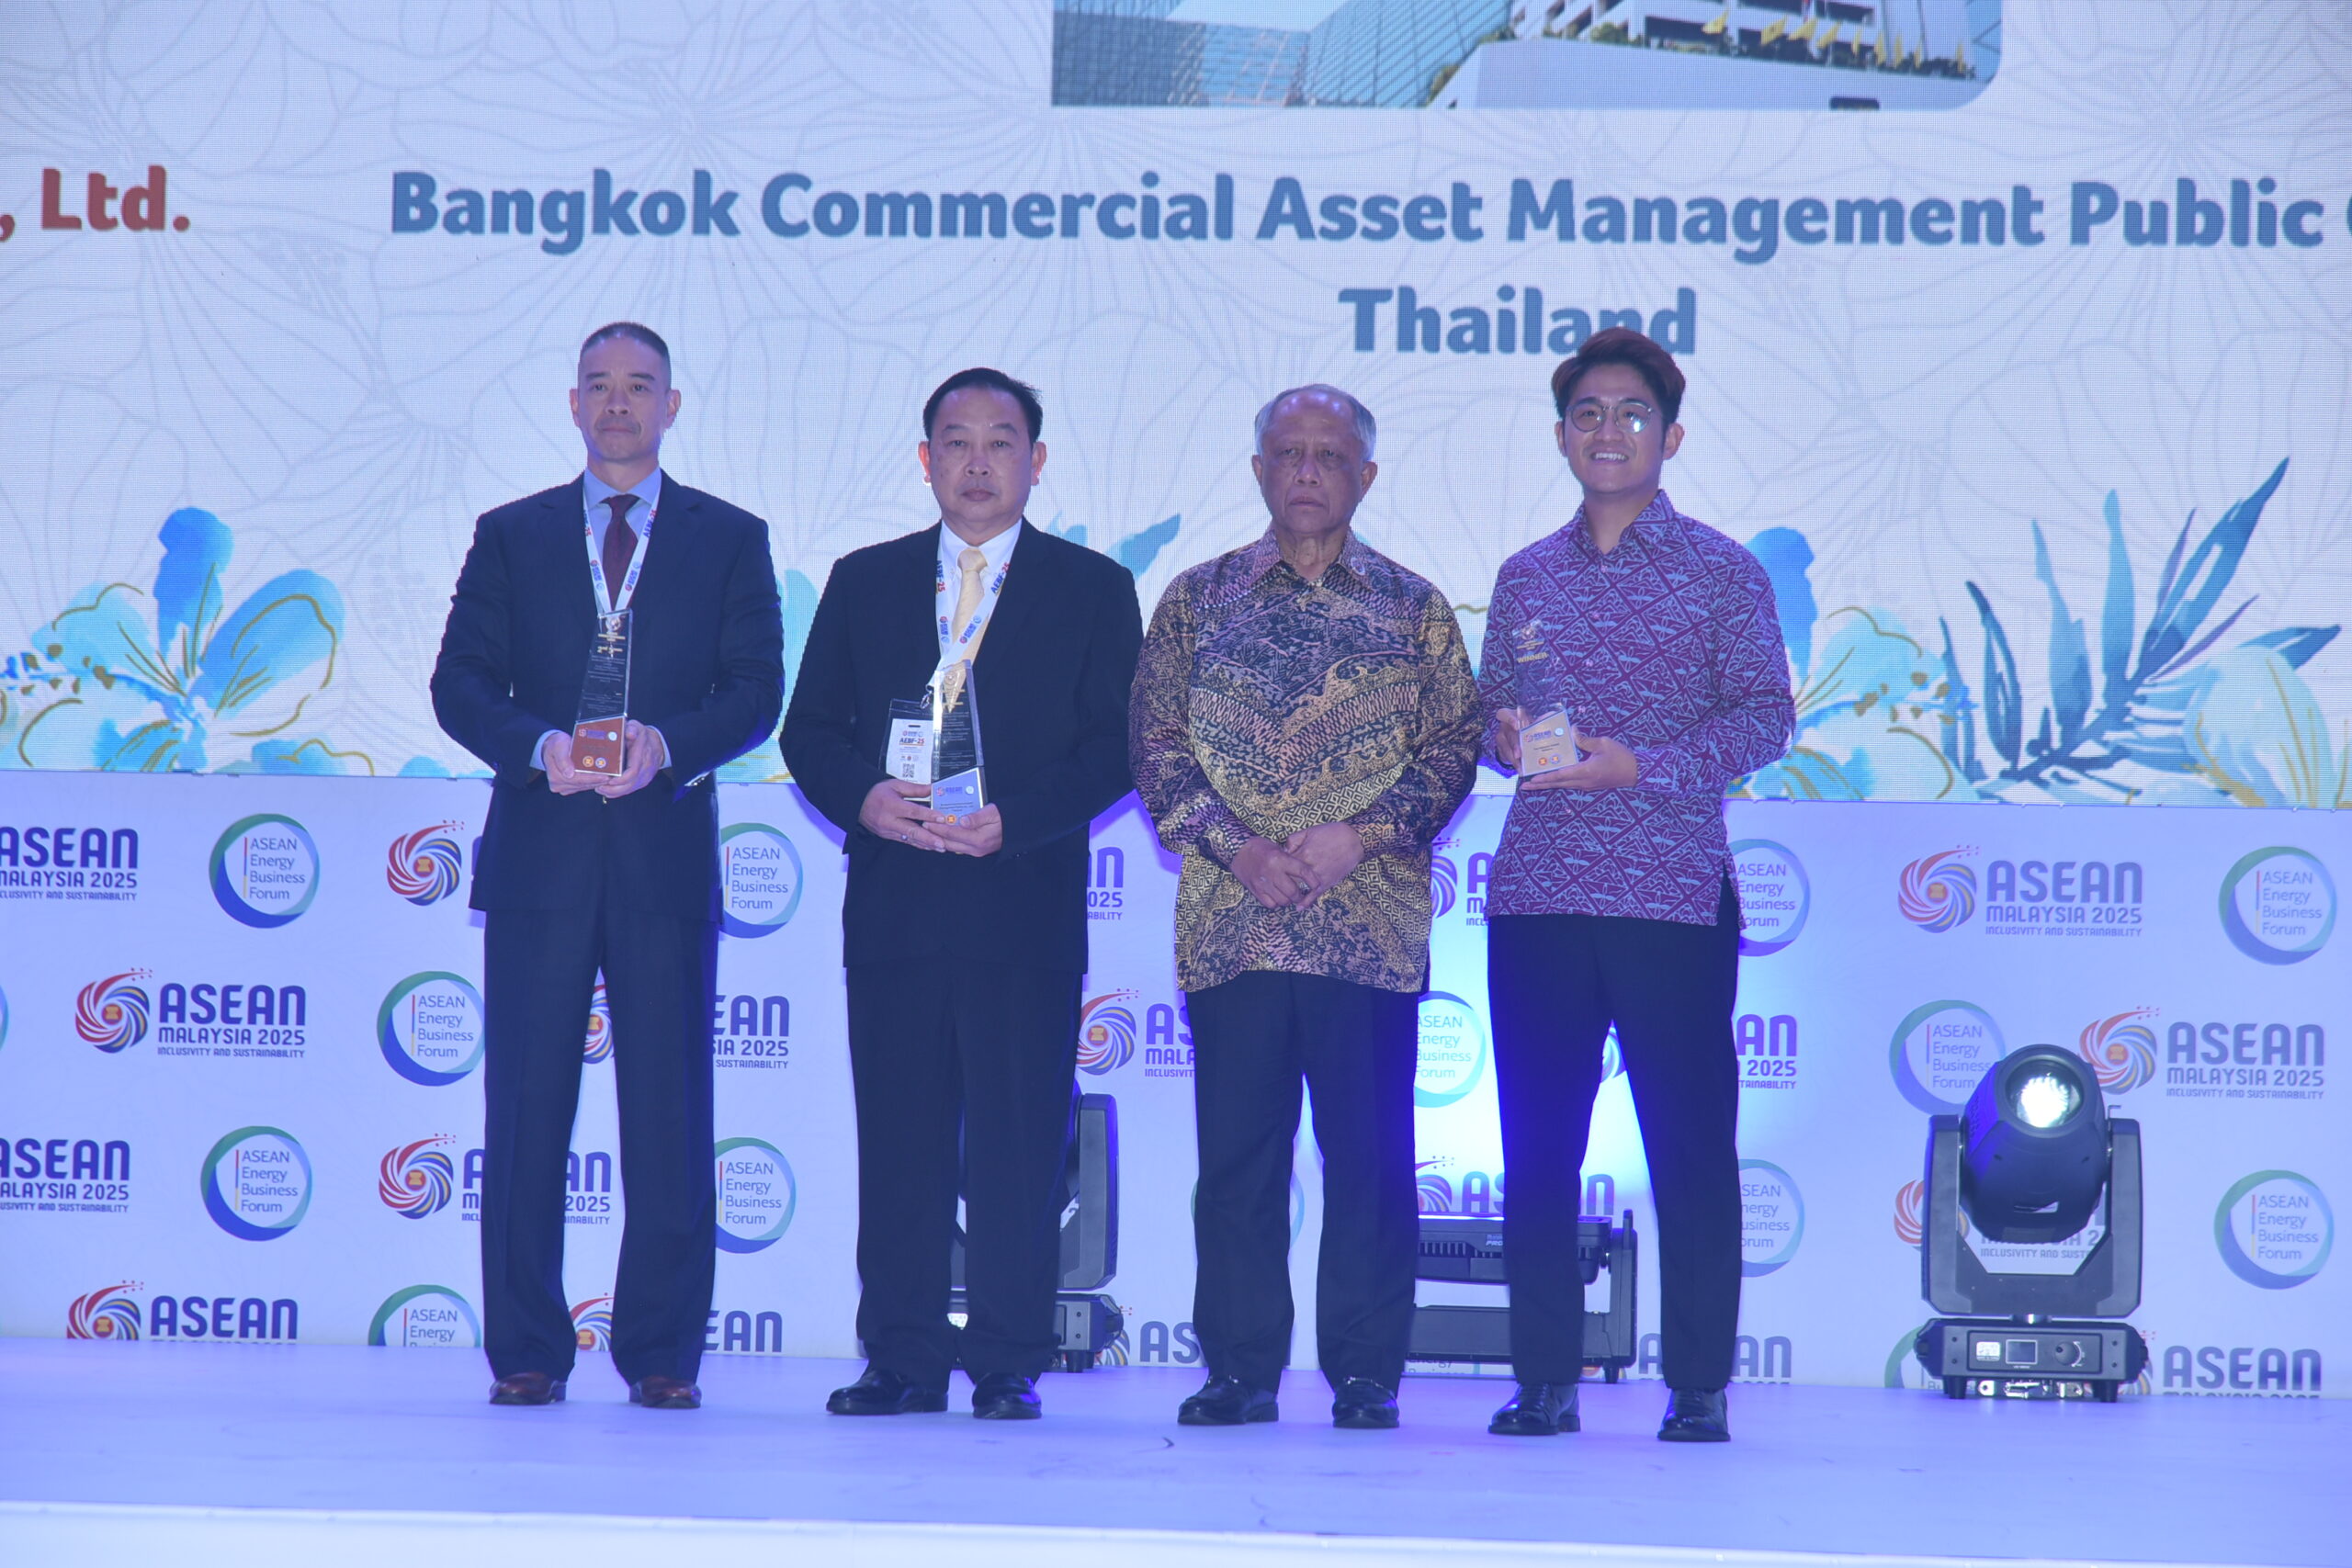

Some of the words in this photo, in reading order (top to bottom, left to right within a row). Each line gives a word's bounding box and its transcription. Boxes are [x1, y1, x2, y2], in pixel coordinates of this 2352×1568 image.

[42, 165, 190, 231] Ltd.
[392, 168, 740, 255] Bangkok
[761, 171, 1233, 240] Commercial
[1257, 176, 1485, 242] Asset
[1507, 178, 2045, 265] Management
[2070, 178, 2325, 248] Public
[0, 827, 138, 869] ASEAN
[250, 838, 297, 851] ASEAN
[732, 847, 781, 861] ASEAN
[251, 854, 295, 870] Energy
[732, 863, 778, 880] Energy
[1737, 863, 1786, 876] ASEAN
[90, 872, 138, 888] 2025
[249, 871, 306, 884] Business
[1986, 860, 2143, 904] ASEAN
[2262, 872, 2312, 886] ASEAN
[249, 887, 290, 900] Forum
[731, 880, 788, 894] Business
[0, 890, 43, 899] CLUSIVITY
[46, 891, 63, 900] AND
[65, 891, 137, 901] SUSTAINABILITY
[1088, 891, 1123, 908] 025
[2263, 888, 2311, 905] Energy
[731, 897, 773, 909] Forum
[1986, 906, 2086, 923] MALAYSIA
[2091, 908, 2143, 924] 2025
[2263, 905, 2322, 919] Business
[1745, 917, 1780, 927] orum
[2262, 922, 2306, 936] Forum
[1985, 926, 2041, 935] INCLUSIVITY
[2044, 926, 2063, 936] AND
[2065, 927, 2142, 937] SUSTAINABILITY
[159, 983, 306, 1026] ASEAN
[418, 995, 466, 1009] ASEAN
[418, 1011, 463, 1028] Energy
[713, 995, 789, 1037] EAN
[158, 1027, 251, 1045] MALAYSIA
[257, 1028, 305, 1046] 2025
[417, 1028, 474, 1042] Business
[1933, 1024, 1983, 1038] ASEAN
[741, 1039, 789, 1056] 2025
[1933, 1042, 1980, 1058] Energy
[2166, 1021, 2324, 1066] ASEAN
[157, 1046, 211, 1056] INCLUSIVITY
[213, 1047, 231, 1057] AND
[233, 1048, 305, 1058] SUSTAINABILITY
[417, 1045, 458, 1058] Forum
[1146, 1048, 1195, 1066] MALA
[716, 1059, 788, 1069] SUSTAINABILITY
[1747, 1059, 1797, 1077] 2025
[1145, 1068, 1195, 1077] INCLUSIVIT
[2166, 1066, 2267, 1085] MALAYSIA
[2273, 1069, 2324, 1087] 2025
[1738, 1080, 1796, 1089] TAINABILITY
[1933, 1076, 1975, 1089] Forum
[2166, 1088, 2222, 1098] INCLUSIVITY
[2226, 1089, 2245, 1099] AND
[2247, 1089, 2324, 1100] SUSTAINABILITY
[242, 1151, 290, 1163] ASEAN
[242, 1168, 288, 1183] Energy
[725, 1162, 774, 1176] ASEAN
[0, 1181, 76, 1199] ALAYSIA
[83, 1183, 130, 1201] 2025
[242, 1184, 299, 1197] Business
[726, 1179, 772, 1195] Energy
[1742, 1184, 1781, 1197] SEAN
[0, 1201, 36, 1211] USIVITY
[38, 1202, 56, 1212] AND
[58, 1203, 129, 1213] SUSTAINABILITY
[241, 1201, 283, 1213] Forum
[565, 1195, 611, 1213] 2025
[726, 1195, 782, 1209] Business
[2257, 1195, 2310, 1209] ASEAN
[1741, 1204, 1779, 1218] nergy
[564, 1215, 610, 1224] INABILITY
[725, 1213, 767, 1225] Forum
[1741, 1218, 1791, 1232] usiness
[2258, 1213, 2307, 1229] Energy
[1741, 1238, 1774, 1248] orum
[2258, 1229, 2319, 1244] Business
[1981, 1247, 2037, 1258] INCLUSIVITY
[2040, 1248, 2059, 1258] AND
[2258, 1247, 2302, 1260] Forum
[150, 1295, 298, 1339] ASEAN
[410, 1309, 458, 1322] ASEAN
[410, 1325, 456, 1342] Energy
[705, 1310, 783, 1353] EAN
[2164, 1345, 2322, 1392] ASEAN
